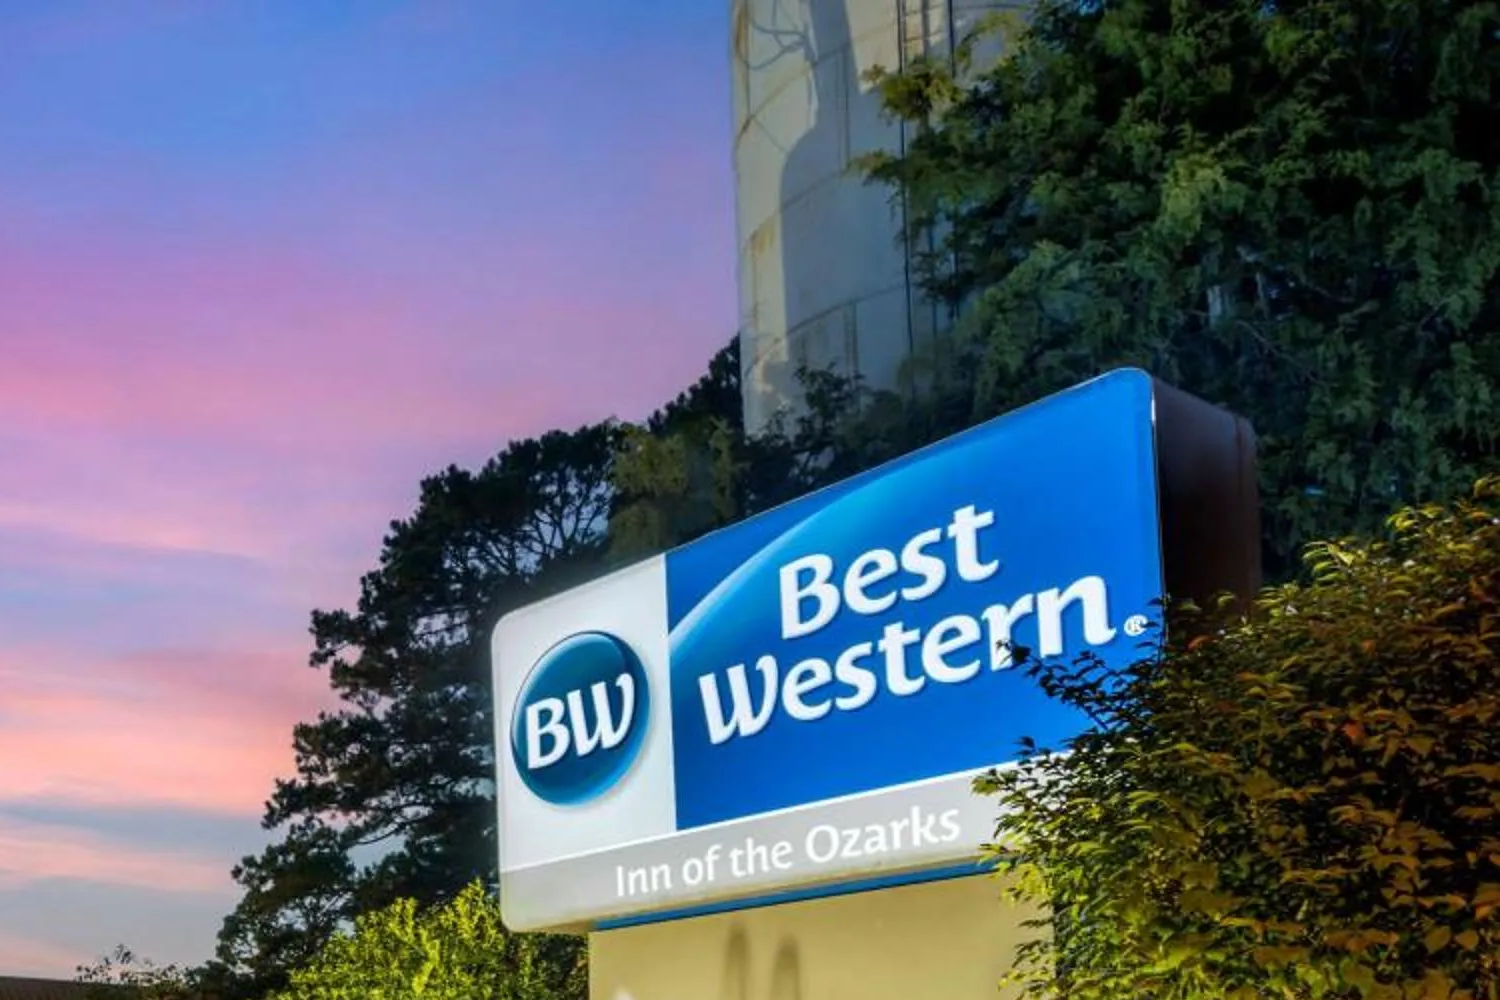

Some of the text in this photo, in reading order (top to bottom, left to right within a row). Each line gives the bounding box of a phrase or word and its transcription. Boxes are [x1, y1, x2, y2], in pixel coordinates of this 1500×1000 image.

[779, 504, 999, 640] Best
[699, 575, 1116, 745] Western
[526, 673, 635, 769] BW
[616, 805, 961, 897] Inn of the Ozarks
